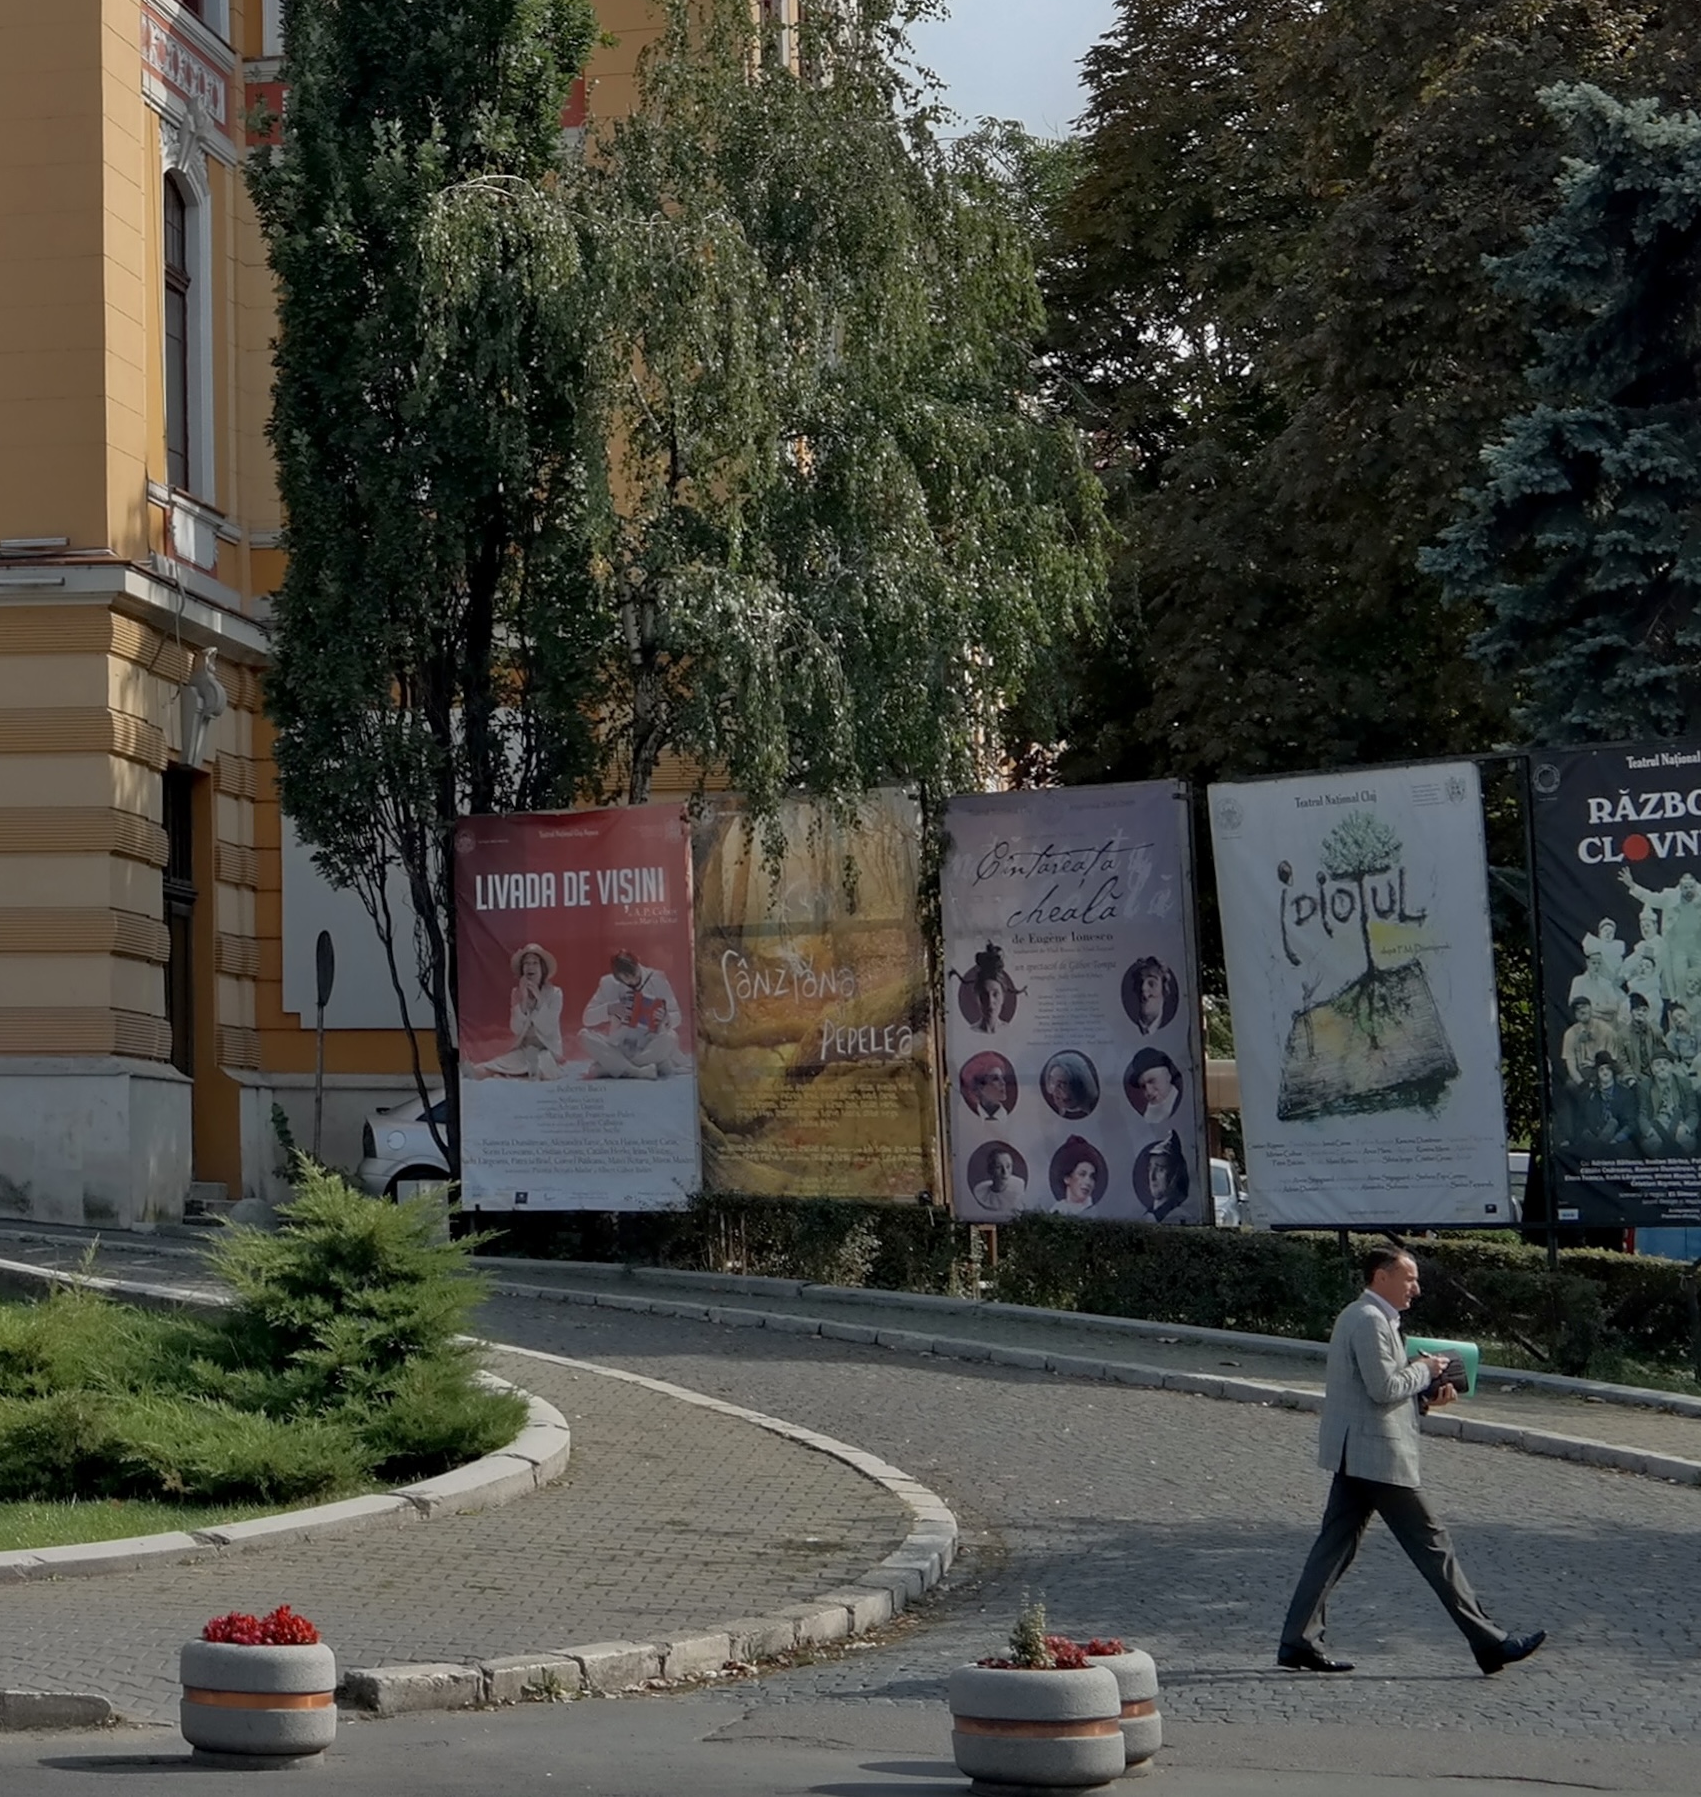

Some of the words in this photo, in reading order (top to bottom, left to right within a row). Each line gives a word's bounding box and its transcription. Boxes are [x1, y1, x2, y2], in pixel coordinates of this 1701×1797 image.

[1626, 755, 1659, 769] Teatrul
[1294, 795, 1323, 809] Teatrul
[475, 872, 556, 910] LIVADA
[563, 871, 591, 906] DE
[597, 867, 665, 914] VIȘINI
[1011, 934, 1025, 944] de
[1028, 932, 1067, 944] Eugène
[1071, 931, 1114, 942] Ionesco
